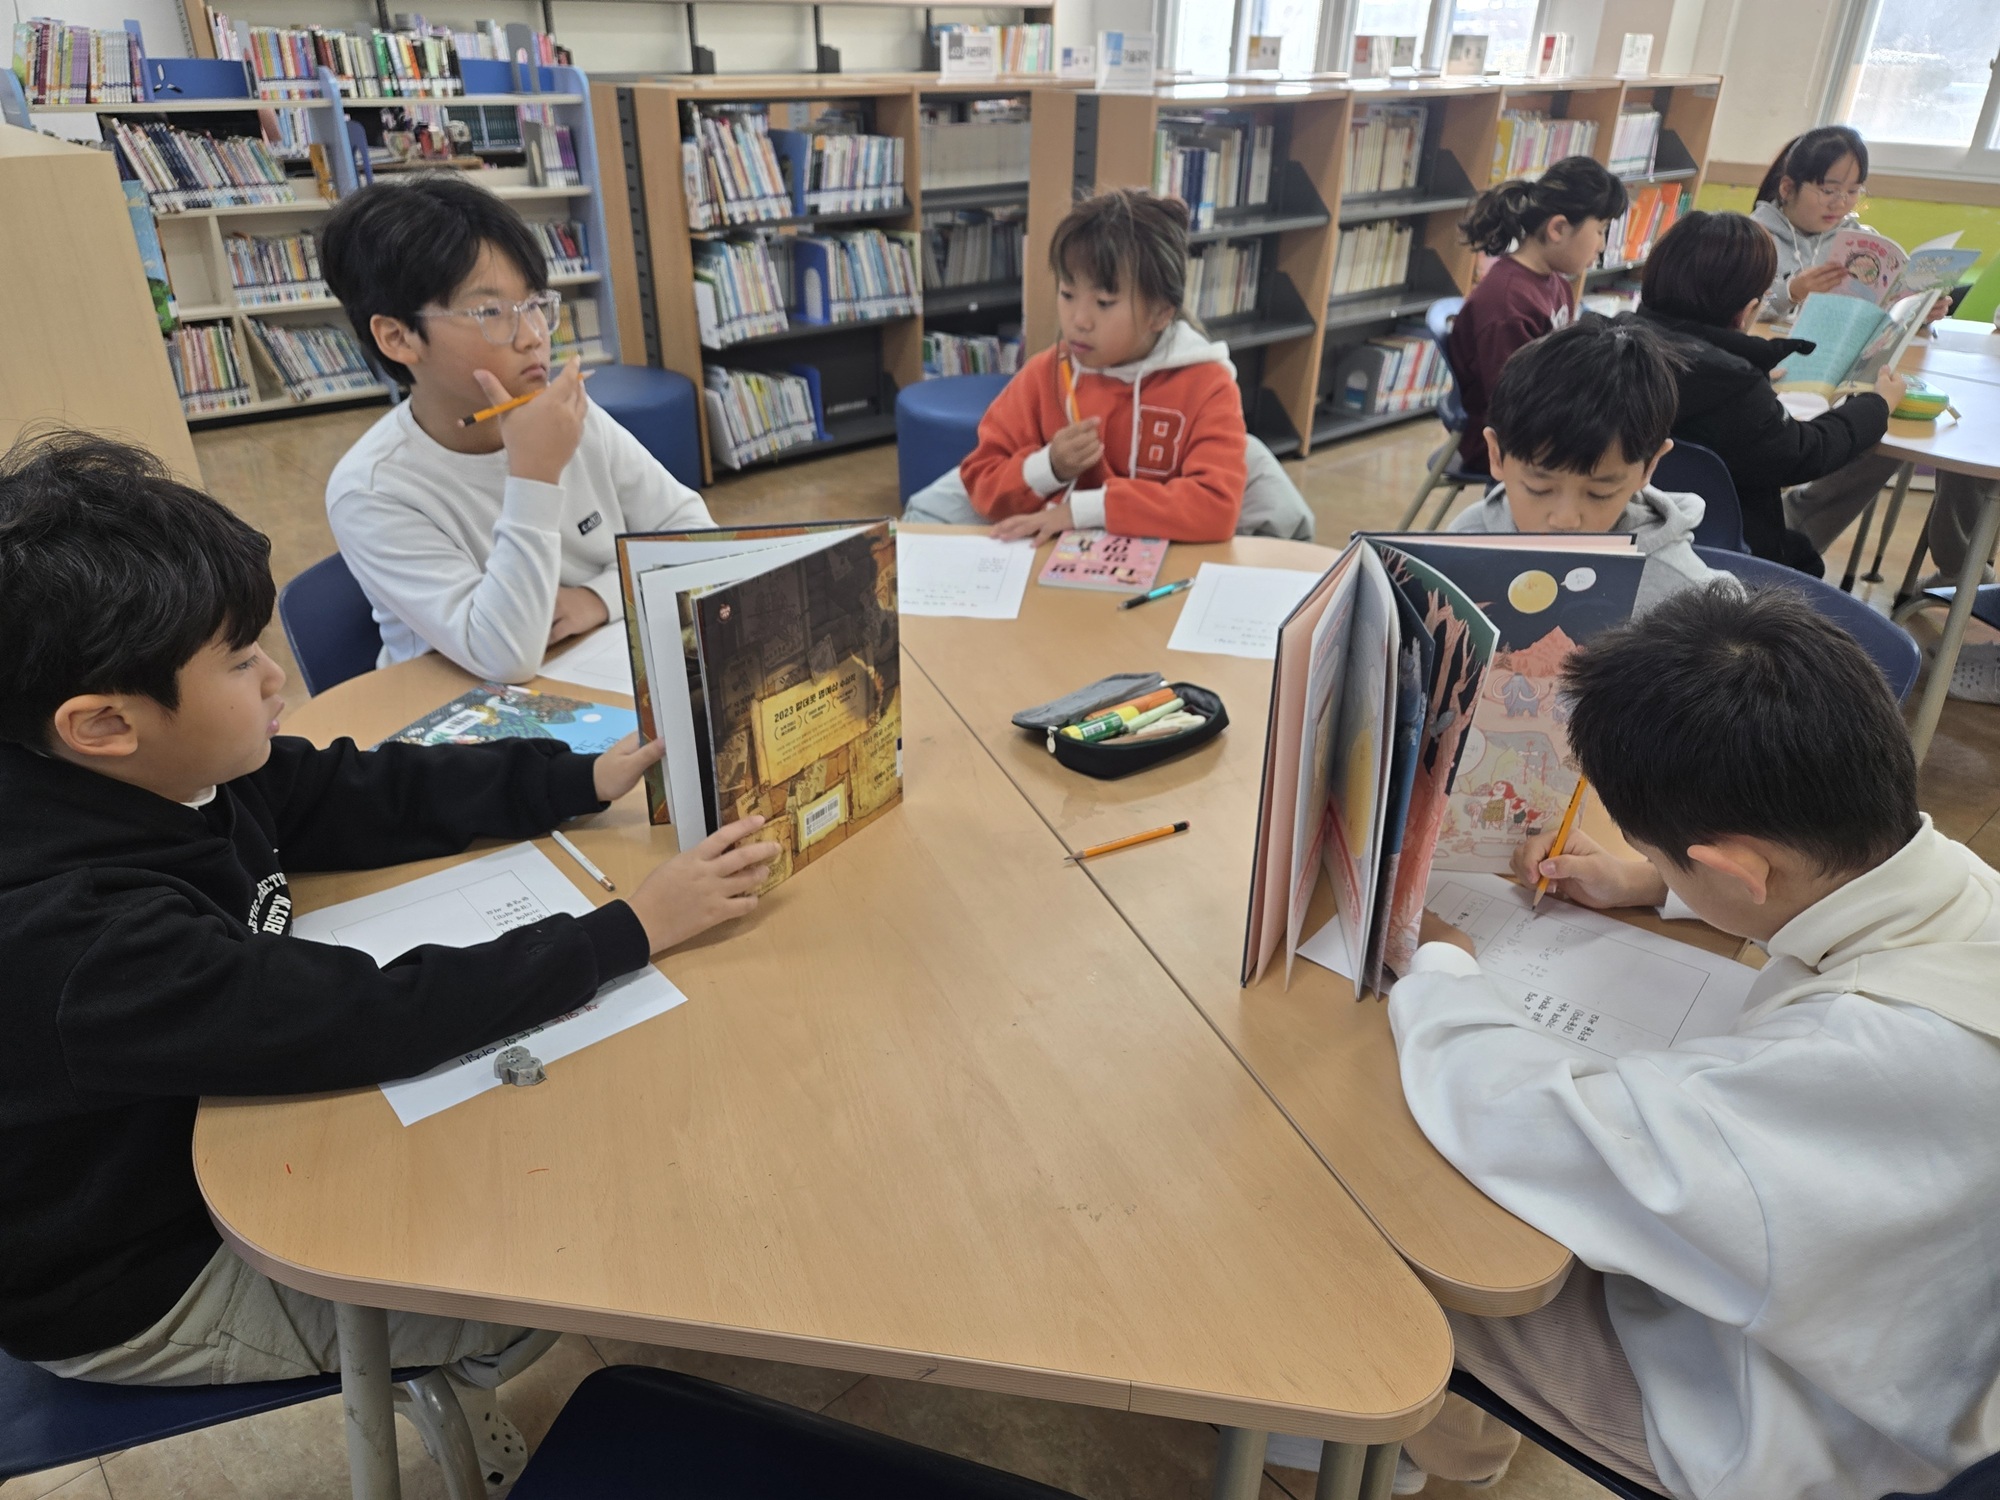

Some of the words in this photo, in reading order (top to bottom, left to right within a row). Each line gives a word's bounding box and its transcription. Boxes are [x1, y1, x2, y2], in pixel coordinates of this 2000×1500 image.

[1134, 404, 1187, 476] B
[774, 706, 794, 723] 2023
[262, 894, 291, 935] HGTN
